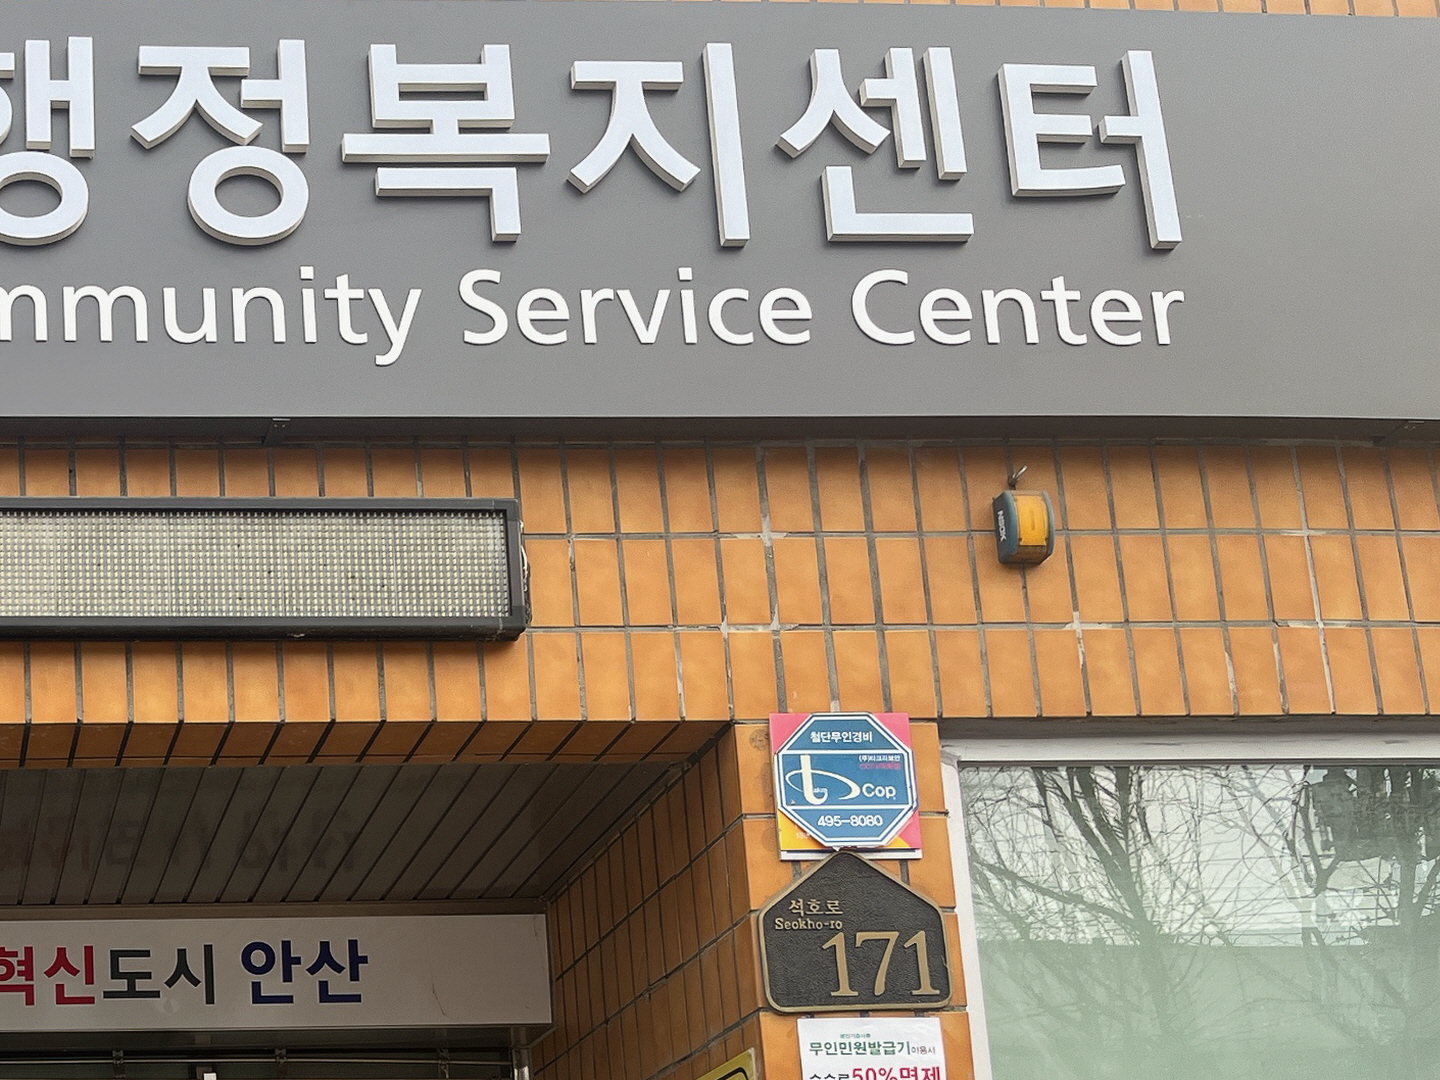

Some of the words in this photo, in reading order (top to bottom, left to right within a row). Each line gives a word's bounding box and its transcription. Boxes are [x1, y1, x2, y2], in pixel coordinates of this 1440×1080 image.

[459, 266, 812, 346] Service
[851, 268, 1186, 346] Center
[862, 783, 896, 799] Cop
[817, 815, 883, 827] 495-8080
[788, 899, 843, 916] 석호로
[775, 918, 843, 930] Seokho-ro
[822, 930, 940, 996] 171
[240, 939, 369, 1005] 안산
